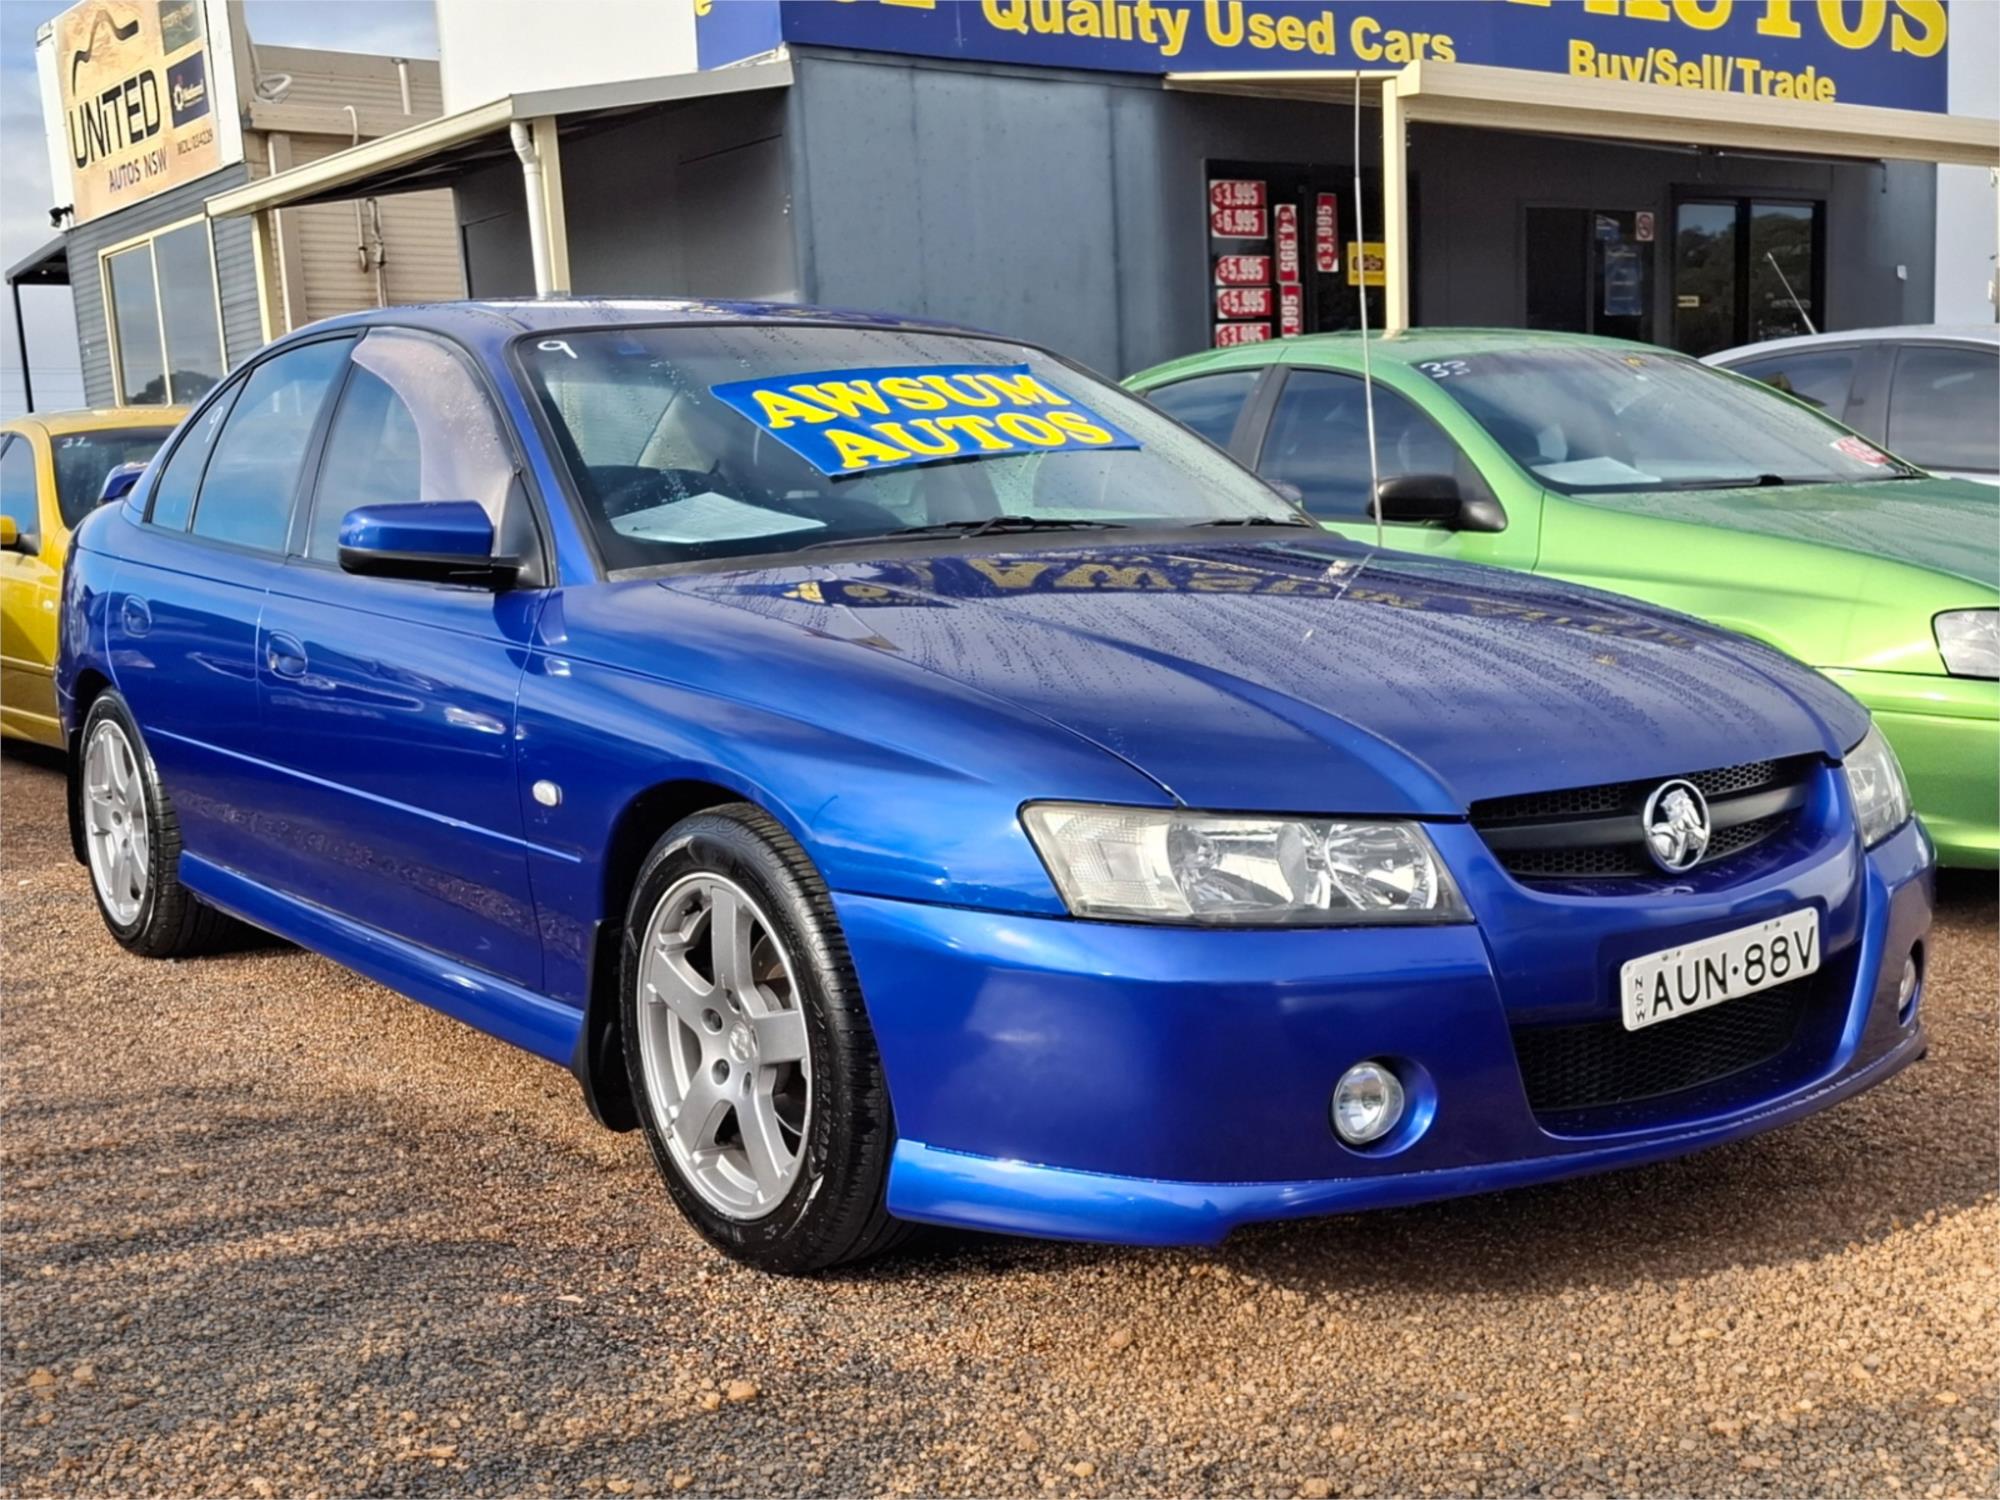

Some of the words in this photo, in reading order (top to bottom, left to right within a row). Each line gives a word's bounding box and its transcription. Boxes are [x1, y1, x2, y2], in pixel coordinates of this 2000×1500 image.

[981, 0, 1190, 56] Quality
[1204, 0, 1336, 56] Used
[1350, 16, 1457, 63] Cars
[108, 159, 141, 193] AUTOS
[143, 147, 168, 179] NSW
[536, 340, 579, 359] 9
[1420, 360, 1471, 378] 33
[751, 373, 1072, 430] AWSUM
[824, 411, 1115, 470] AUTOS
[1634, 975, 1646, 1023] NSW
